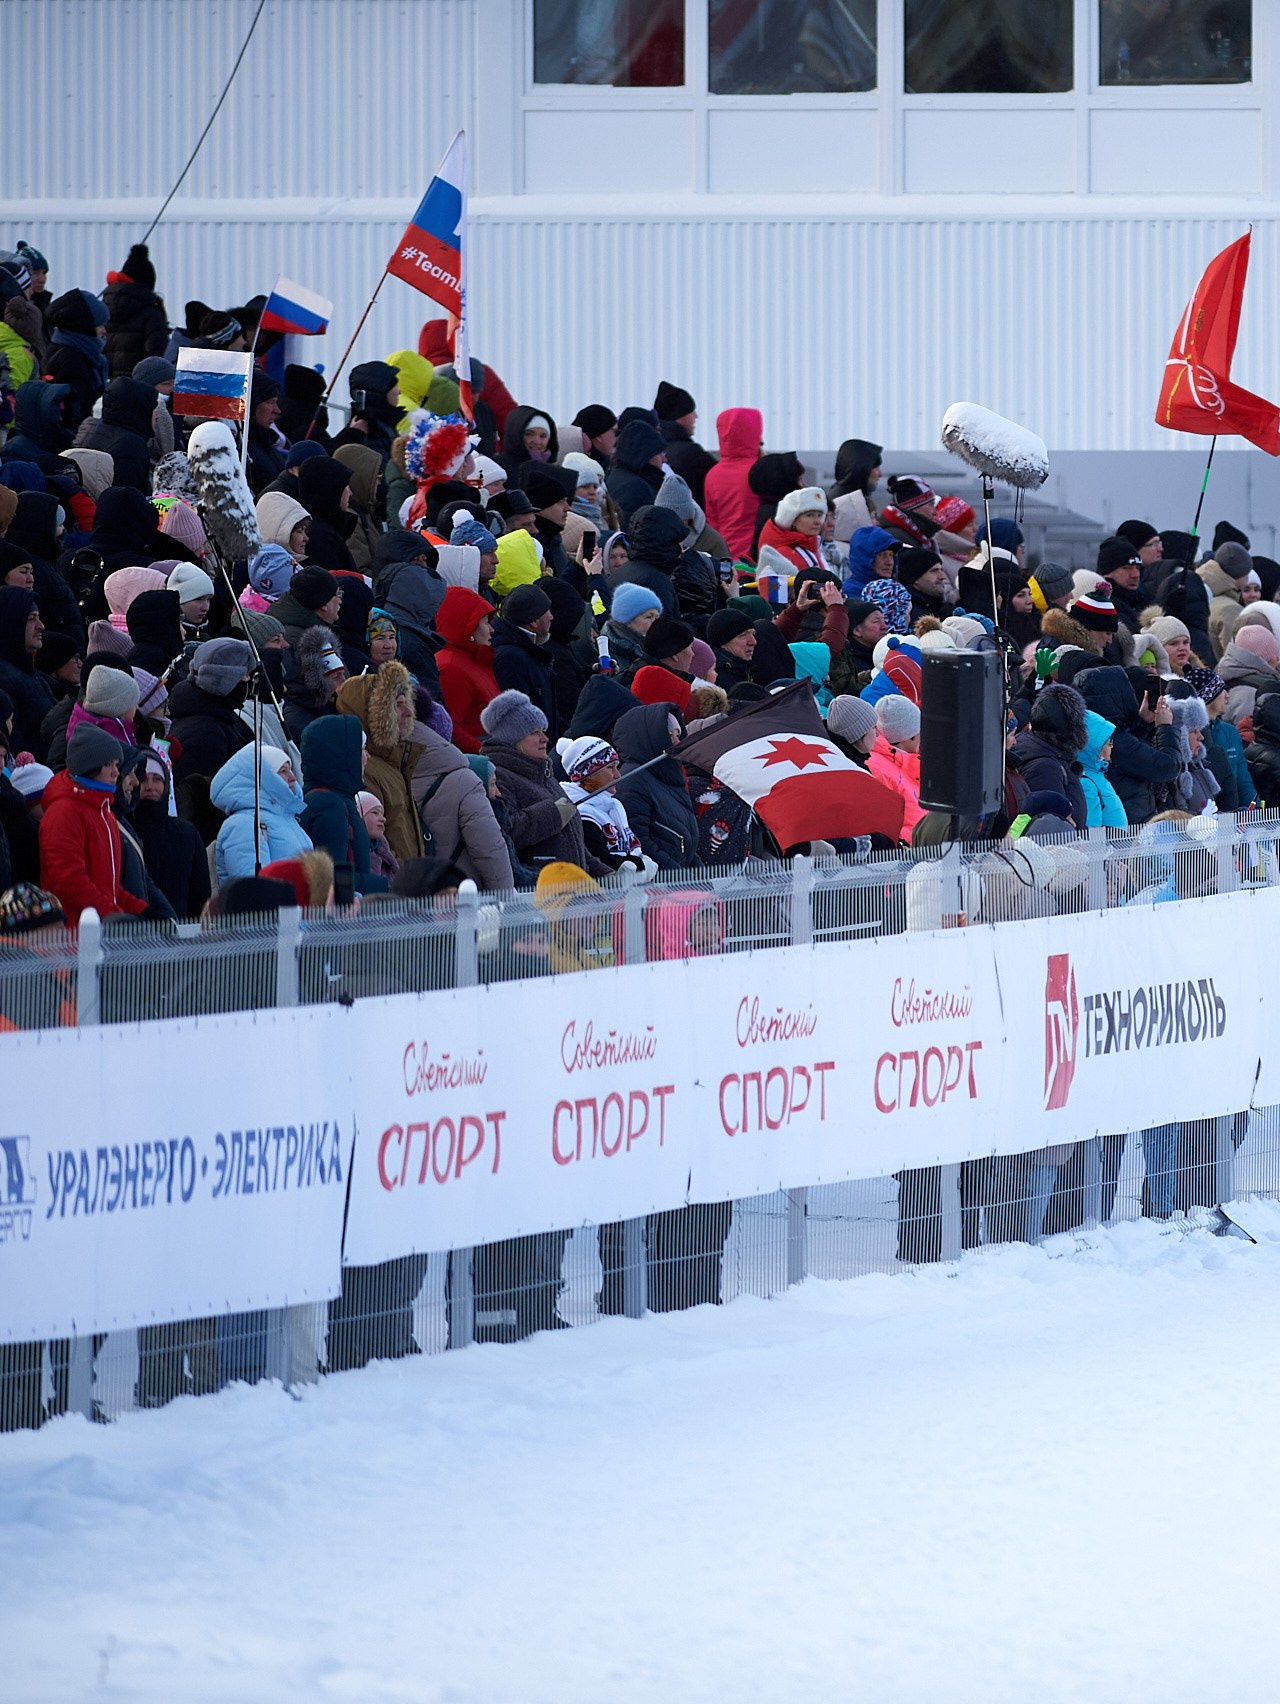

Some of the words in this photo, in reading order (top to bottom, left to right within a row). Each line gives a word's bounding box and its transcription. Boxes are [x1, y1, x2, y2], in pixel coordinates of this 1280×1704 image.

[736, 995, 818, 1048] Светский
[891, 976, 973, 1027] Советский
[1083, 977, 1227, 1058] ТЕХНОНИКОЛЬ
[403, 1040, 488, 1097] Советский
[561, 1019, 657, 1073] Советский
[873, 1040, 983, 1114] СПОРТ
[552, 1084, 675, 1166] СПОРТ
[718, 1061, 836, 1137] СПОРТ
[211, 1119, 343, 1199] ЭЛЕКТРИКА
[377, 1110, 507, 1192] СПОРТ
